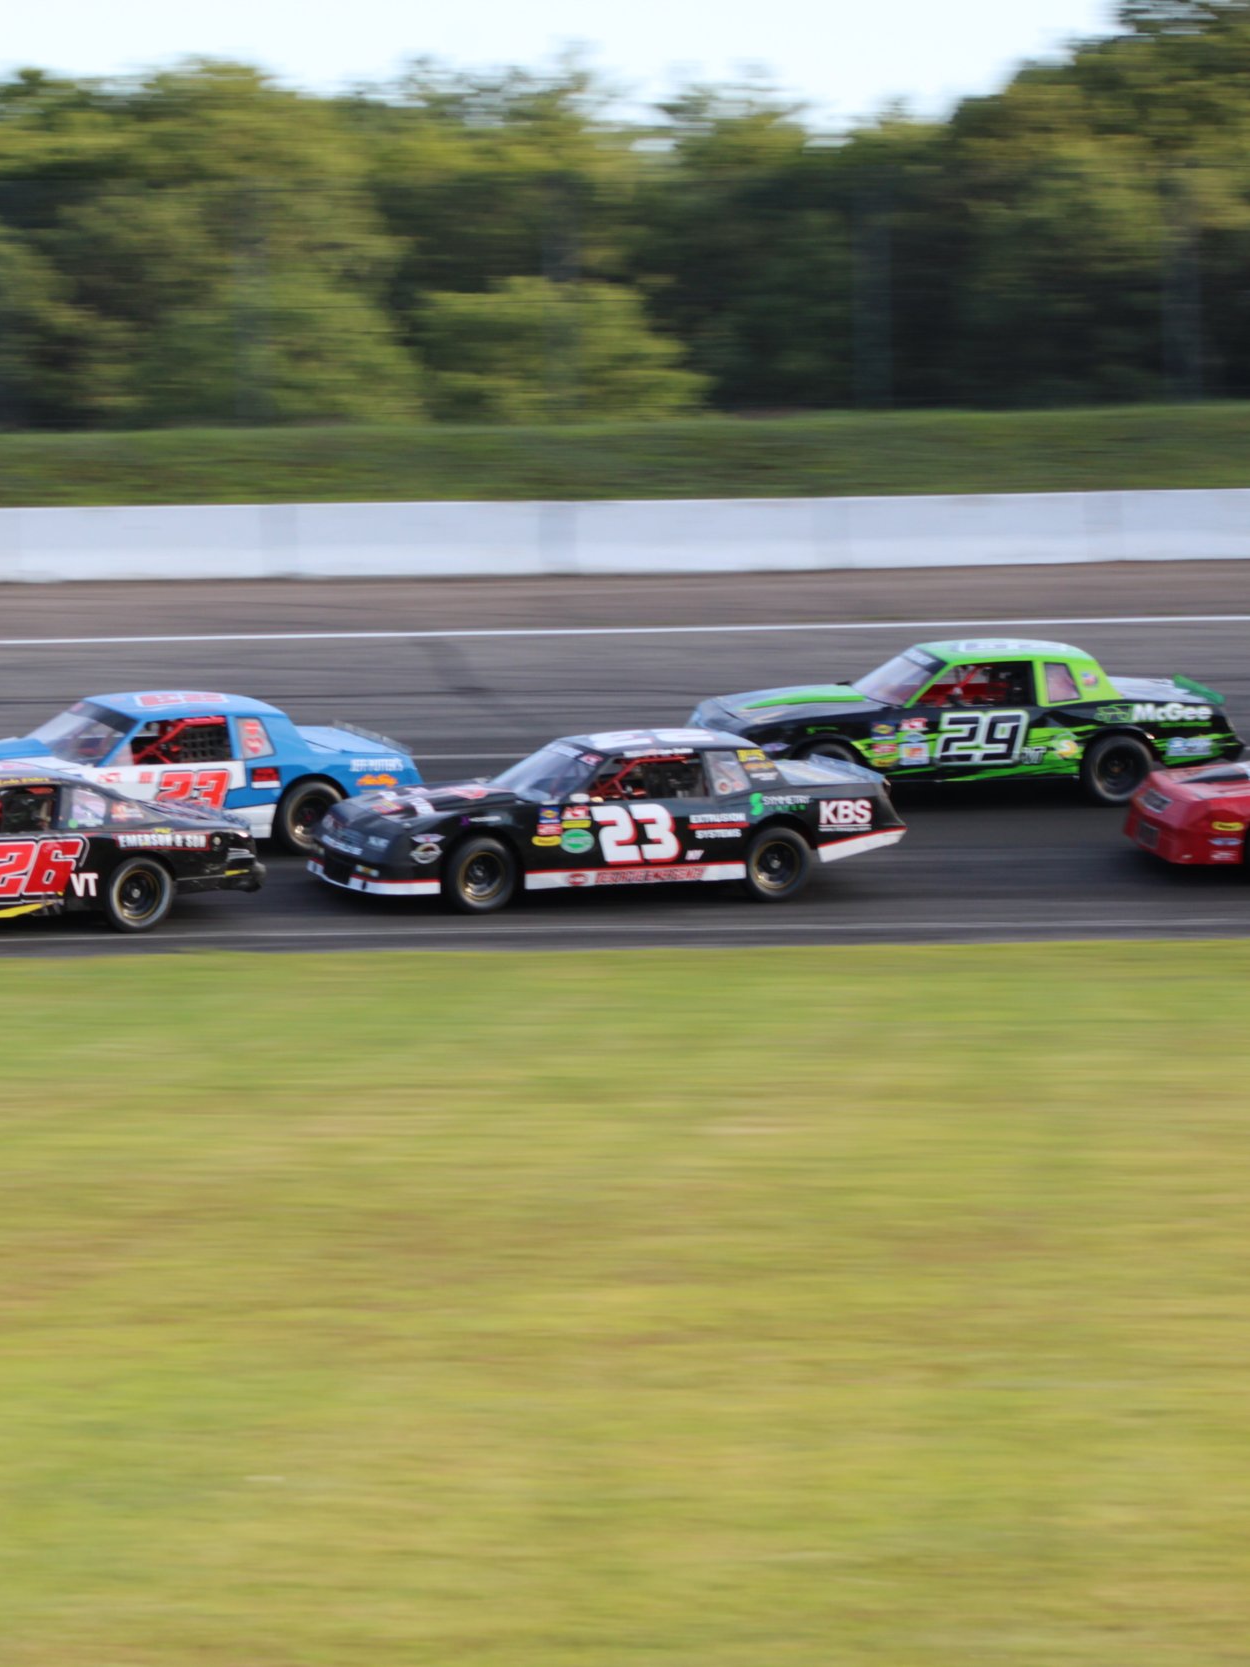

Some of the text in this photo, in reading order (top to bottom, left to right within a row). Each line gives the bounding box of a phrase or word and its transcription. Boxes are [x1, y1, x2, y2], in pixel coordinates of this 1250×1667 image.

[1132, 703, 1213, 722] McGee
[936, 709, 1029, 767] 29
[156, 769, 230, 808] 23
[819, 799, 872, 824] KBS
[591, 803, 682, 865] 23
[70, 873, 98, 896] VT
